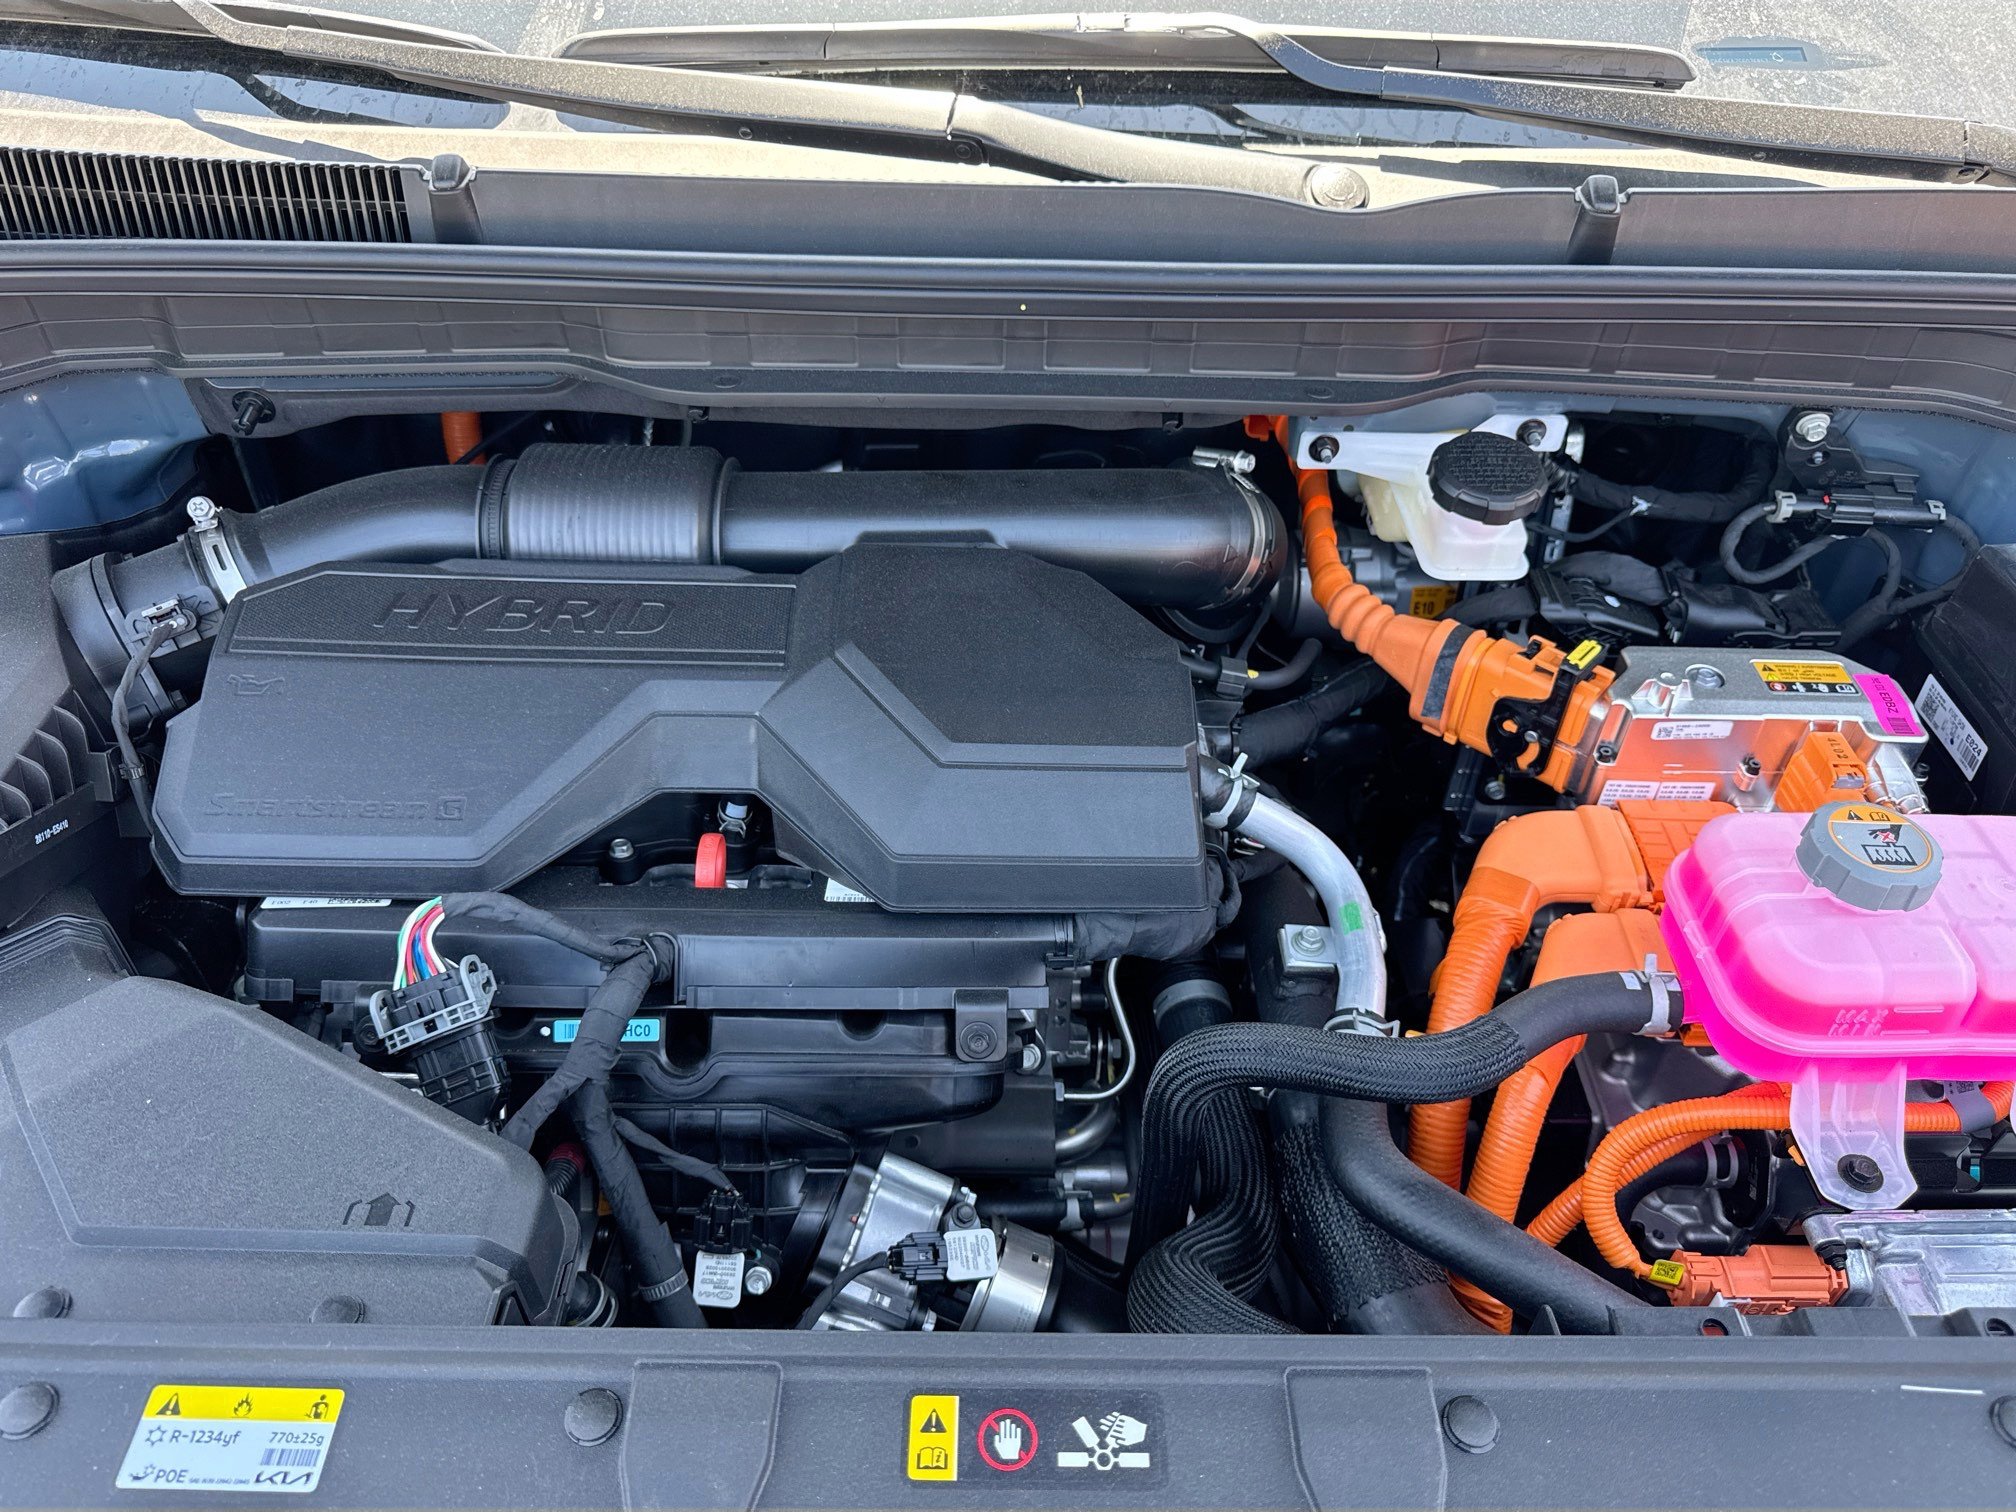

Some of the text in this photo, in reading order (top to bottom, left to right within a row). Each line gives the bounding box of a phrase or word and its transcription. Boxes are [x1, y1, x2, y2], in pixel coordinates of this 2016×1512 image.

[373, 593, 676, 636] HYBRID
[1413, 601, 1435, 616] E10
[203, 793, 467, 821] Smartstream G
[1835, 1009, 1888, 1024] MAX
[169, 1430, 242, 1448] R-1234yf
[268, 1431, 325, 1446] 770±25g
[154, 1469, 189, 1484] POE
